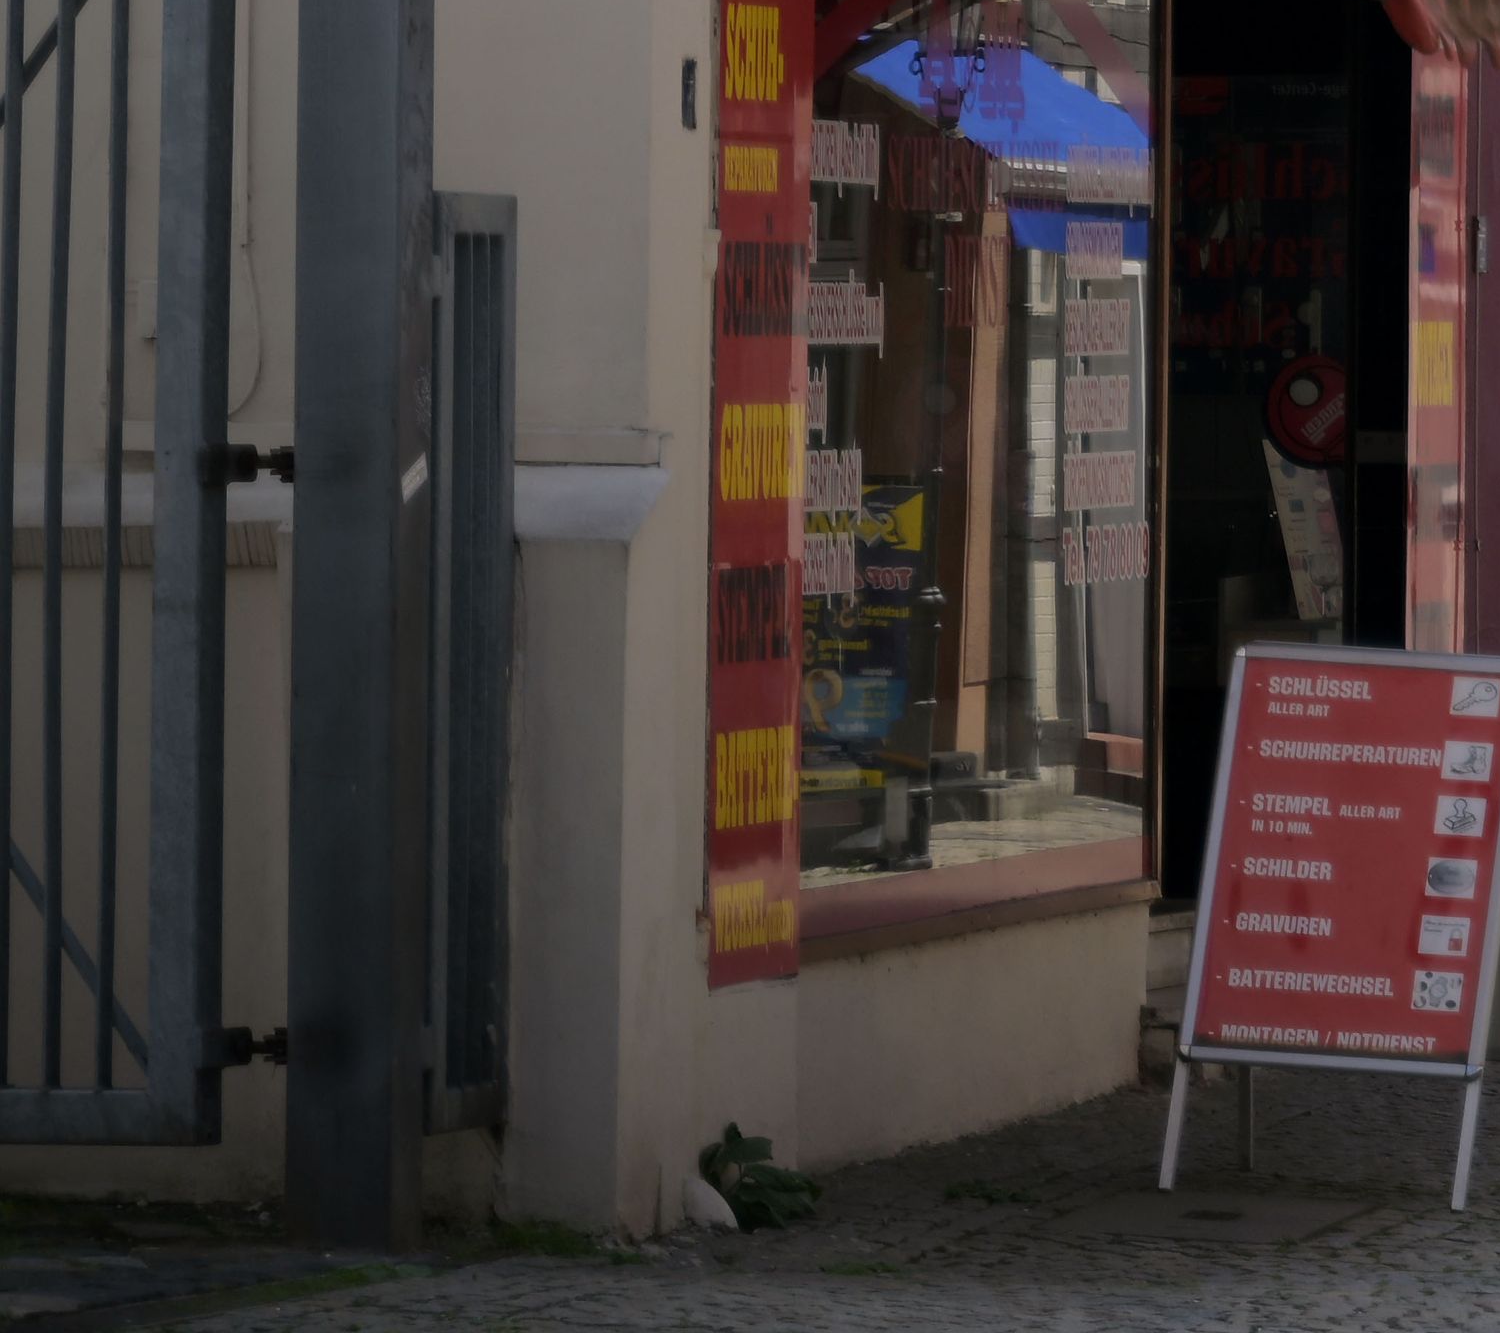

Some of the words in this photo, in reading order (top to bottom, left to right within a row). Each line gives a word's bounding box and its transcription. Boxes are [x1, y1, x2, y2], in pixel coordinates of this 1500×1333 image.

[725, 2, 785, 102] SCHUH-
[1268, 675, 1372, 701] SCHLÜSSEL
[1267, 702, 1304, 716] ALLER
[1306, 704, 1331, 717] ART
[1259, 739, 1441, 767] SCHUHREPERATUREN
[715, 725, 800, 830] BATTERIE-
[1252, 793, 1332, 816] STEMPEL
[1339, 805, 1375, 818] ALLER
[1377, 807, 1401, 819] ART
[1251, 820, 1264, 832] IN
[1268, 820, 1285, 833] 10
[1287, 822, 1313, 835] MIN.
[1243, 857, 1332, 880] SCHILDER
[1235, 913, 1332, 937] GRAVUREN
[1228, 968, 1394, 997] BATTERIEWECHSEL
[1221, 1024, 1319, 1046] MONTAGEN
[1336, 1032, 1436, 1054] NOTDIENST
